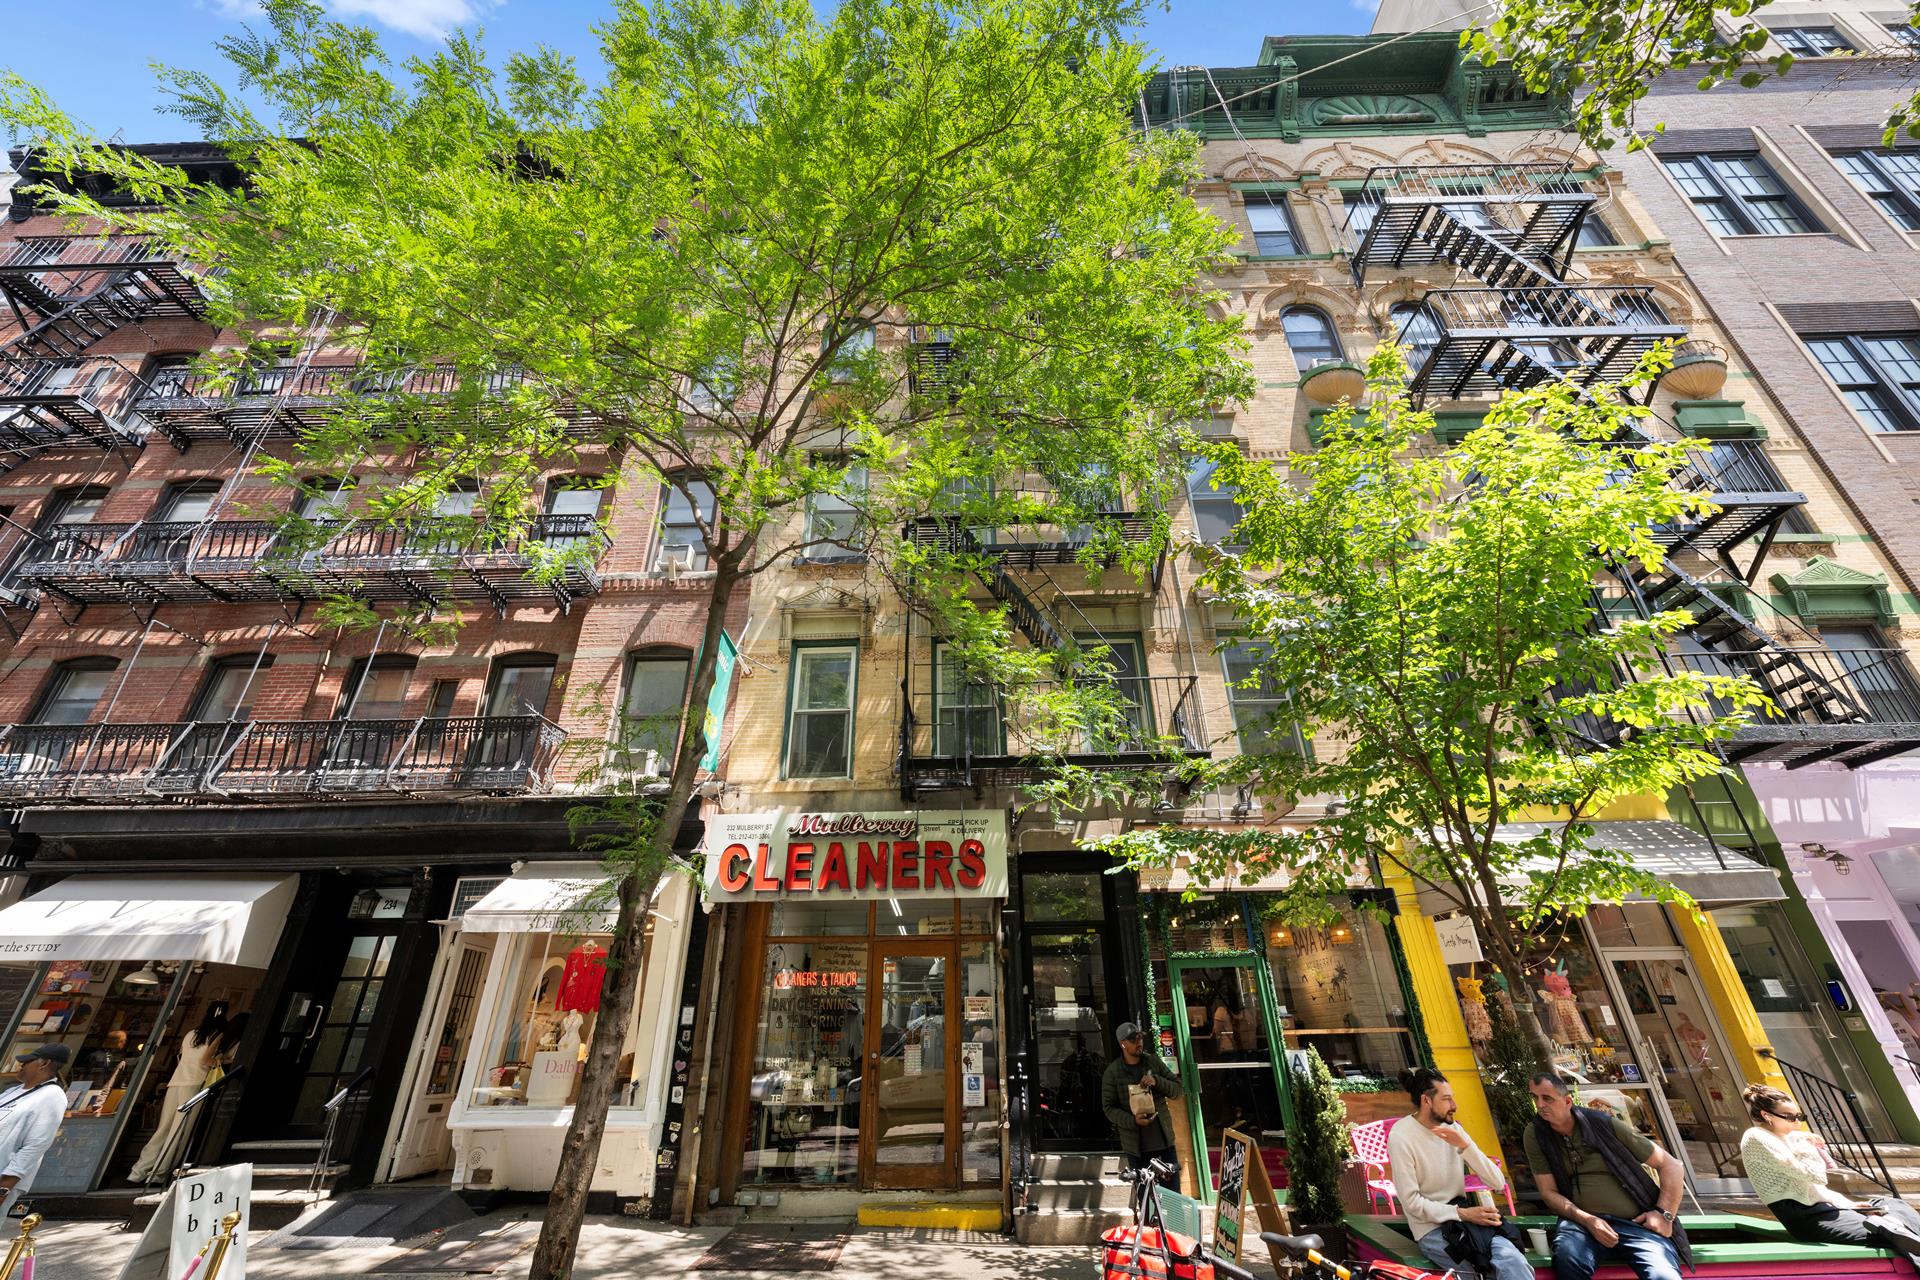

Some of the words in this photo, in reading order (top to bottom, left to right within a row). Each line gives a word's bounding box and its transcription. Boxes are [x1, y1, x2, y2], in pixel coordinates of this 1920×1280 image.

[788, 814, 917, 838] Mulberry
[718, 839, 986, 893] CLEANERS
[383, 900, 397, 910] 234
[4, 941, 23, 952] the
[24, 943, 61, 952] STUDY
[821, 973, 828, 987] &
[830, 971, 857, 986] TAILOR
[829, 987, 839, 995] OF
[772, 998, 794, 1011] DRY
[797, 997, 852, 1011] CLEANING
[1292, 1054, 1306, 1072] A
